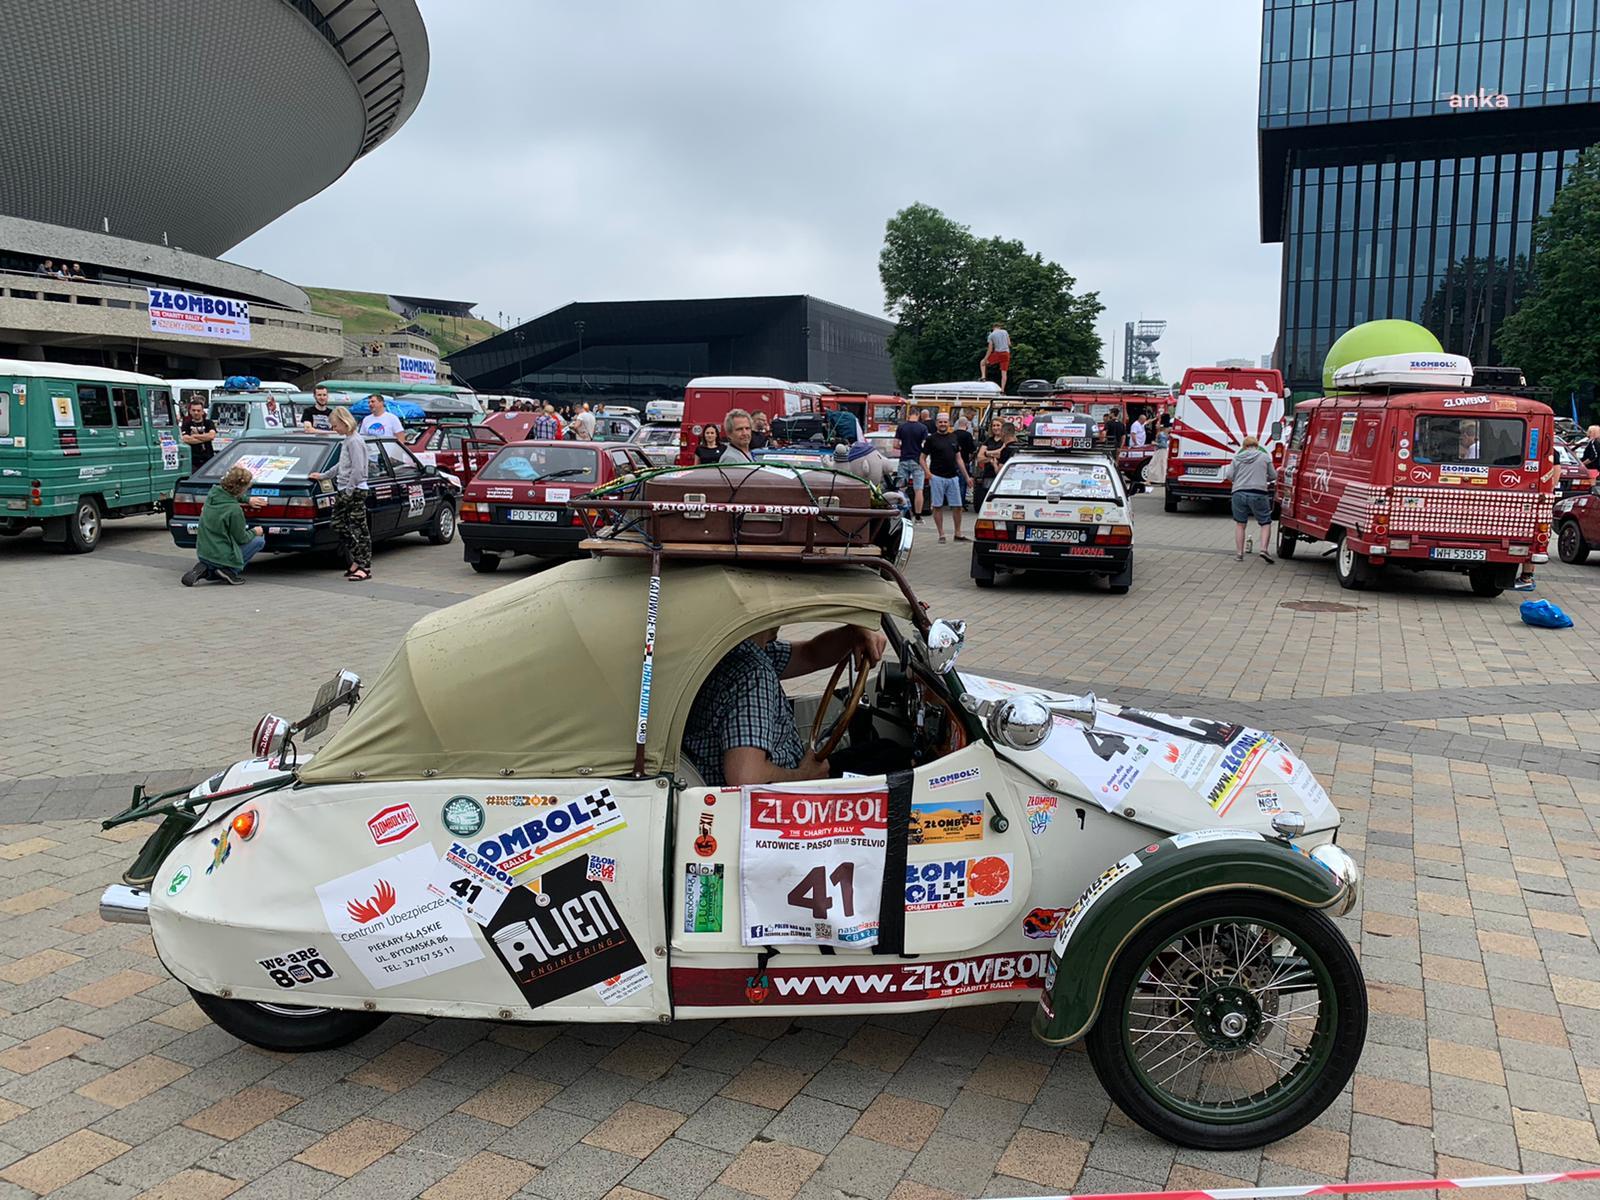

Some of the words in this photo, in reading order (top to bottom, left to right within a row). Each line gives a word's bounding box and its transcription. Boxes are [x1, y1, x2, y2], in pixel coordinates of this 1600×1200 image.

[150, 290, 236, 317] ZŁOMBOL
[161, 311, 184, 319] CHARITY
[1441, 465, 1482, 473] ZŁOMBOL
[1031, 529, 1048, 539] RDE
[1051, 530, 1078, 540] 25790
[997, 543, 1032, 553] IWONA
[1071, 546, 1105, 556] IWONA
[1435, 549, 1451, 559] WH
[1454, 549, 1485, 560] 53855
[929, 770, 973, 786] ZŁOMBOL
[477, 801, 592, 863] OMBOL
[789, 829, 800, 837] THE
[803, 828, 833, 837] CHARITY
[833, 826, 855, 834] RALLY
[755, 840, 800, 851] KATOWICE
[806, 840, 833, 850] PASSO
[850, 838, 886, 848] STELVIO
[502, 852, 529, 870] RALLY
[449, 877, 482, 905] 41
[787, 862, 855, 920] 41
[906, 903, 936, 911] CHARITY
[937, 901, 957, 909] RALLY
[341, 921, 385, 943] Centrum
[386, 896, 449, 927] Ubezpiecze
[368, 935, 405, 953] PIEKARY
[405, 920, 443, 942] ŚLĄSKIE
[375, 953, 389, 964] UL.
[391, 938, 438, 960] BYTOMSKA
[438, 934, 449, 944] 86
[403, 957, 415, 967] 32
[415, 953, 431, 965] 767
[432, 949, 443, 959] 55
[444, 945, 455, 955] 11
[530, 937, 614, 978] ENGINEERING
[269, 958, 334, 988] 800
[940, 988, 952, 996] THE
[954, 983, 989, 994] CHARITY
[989, 980, 1015, 991] RALLY
